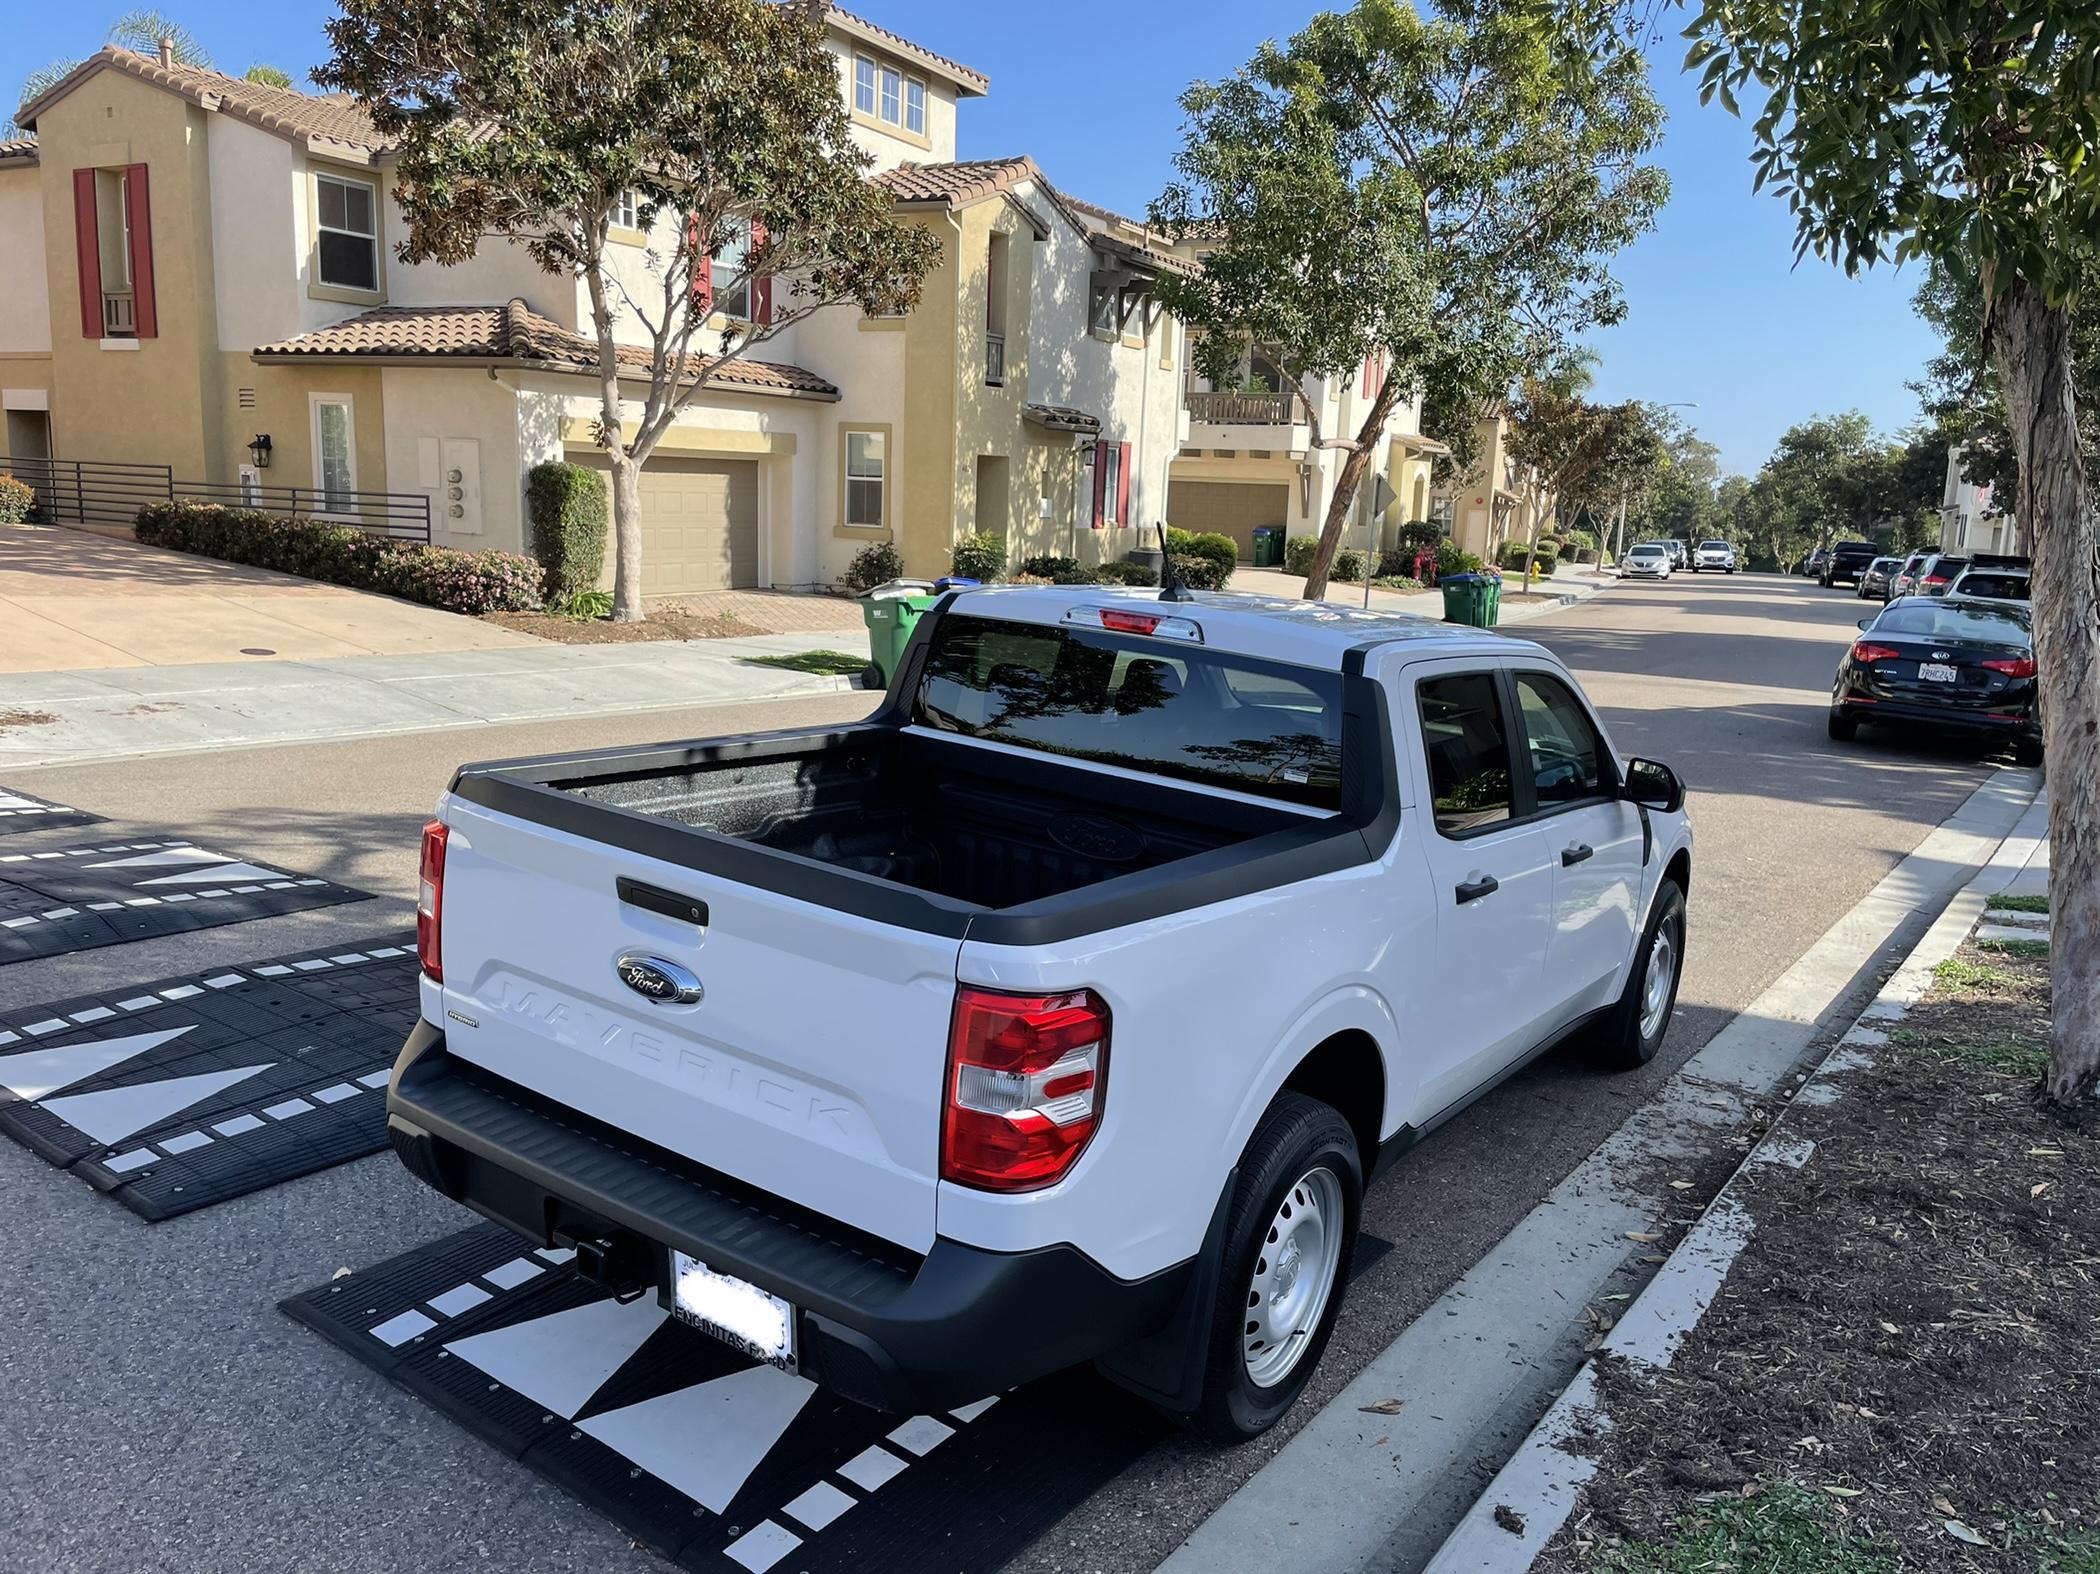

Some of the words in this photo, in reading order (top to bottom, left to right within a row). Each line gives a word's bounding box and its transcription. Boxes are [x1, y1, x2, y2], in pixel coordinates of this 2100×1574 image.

[627, 966, 665, 995] Ford
[489, 981, 850, 1136] MAVERICK
[675, 1306, 745, 1351] ENCINITAS
